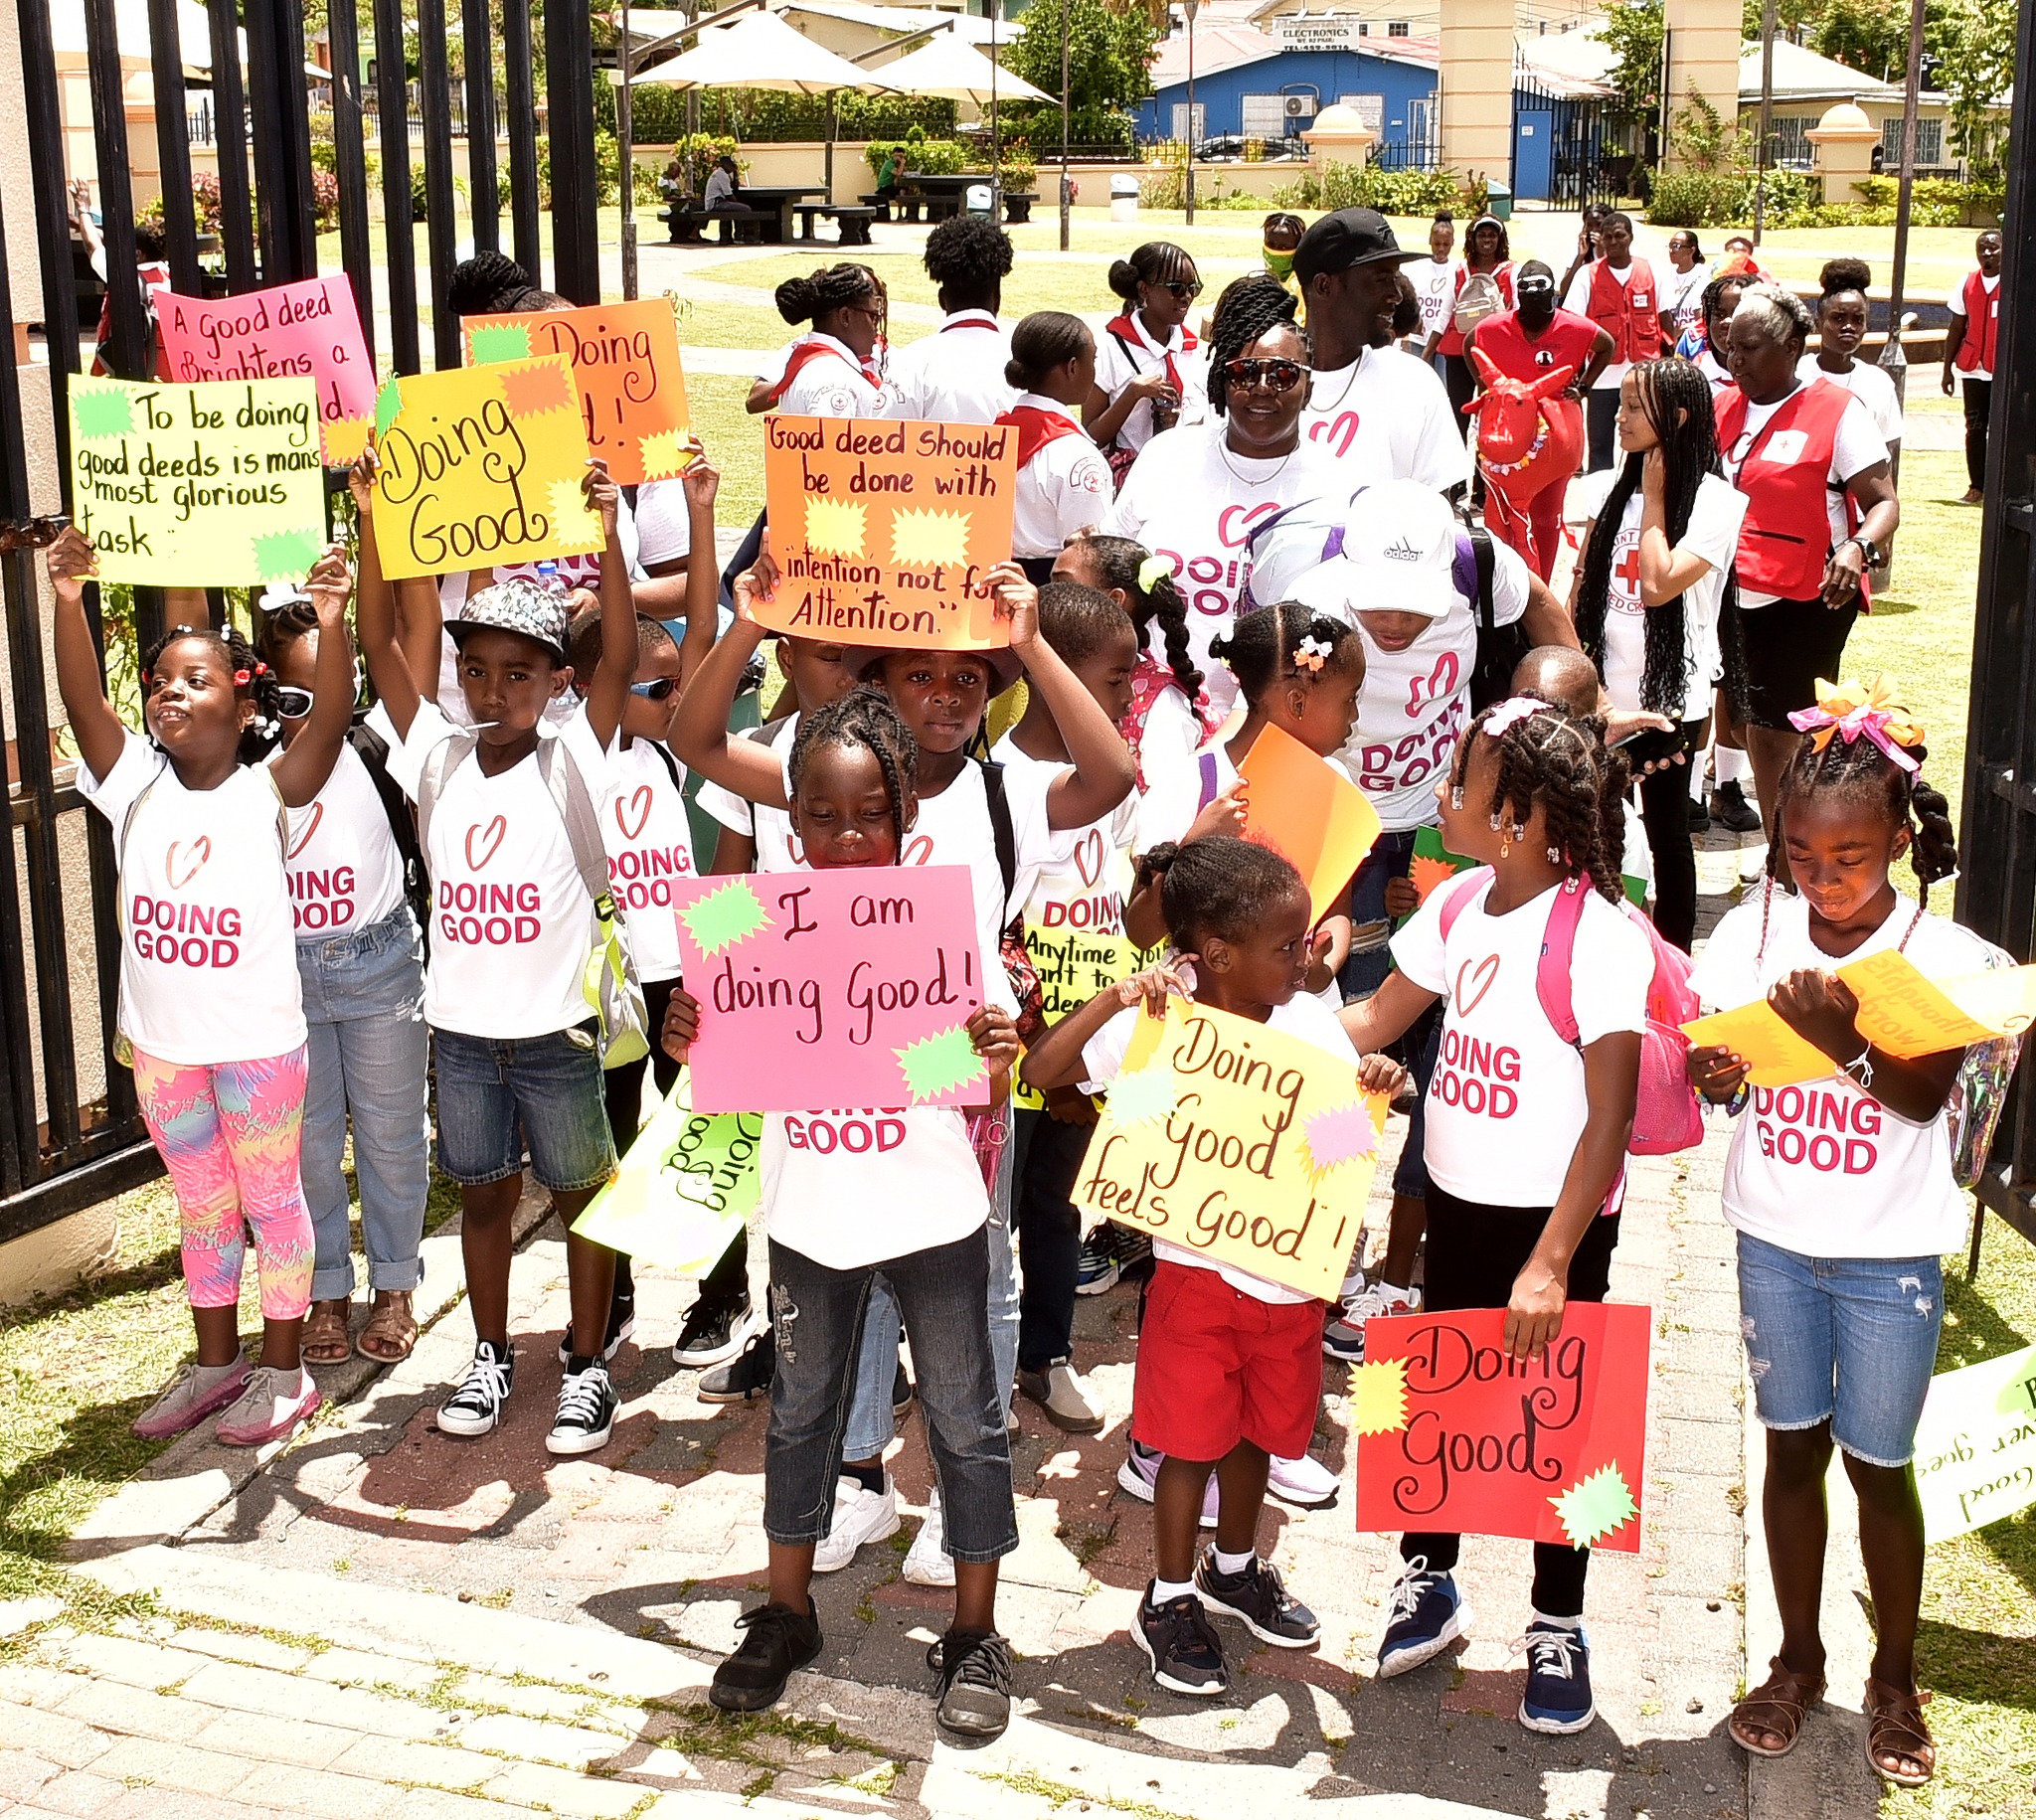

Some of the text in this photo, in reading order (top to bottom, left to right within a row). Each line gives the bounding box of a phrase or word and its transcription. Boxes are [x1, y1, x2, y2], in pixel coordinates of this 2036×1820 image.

[1282, 29, 1349, 38] ELECTRONICS
[174, 283, 333, 360] A Good deed
[331, 344, 351, 366] a
[539, 320, 657, 404] Doing
[189, 389, 225, 429] be
[236, 385, 309, 447] doing
[835, 419, 906, 455] deed
[78, 438, 129, 490] good
[137, 440, 221, 478] deeds
[233, 444, 259, 475] is
[380, 398, 527, 505] Doing
[801, 452, 997, 498] be done with
[94, 476, 288, 522] most glorious
[409, 463, 549, 565] Good
[82, 503, 153, 557] task
[897, 566, 947, 592] not
[1609, 593, 1624, 608] ED
[132, 895, 242, 937] DOING
[439, 879, 541, 914] DOING
[777, 885, 915, 942] I am
[134, 932, 240, 969] GOOD
[440, 912, 542, 944] GOOD
[1025, 930, 1117, 968] Anytime
[712, 947, 979, 1046] doing Good!
[1091, 968, 1116, 989] to
[1172, 1017, 1305, 1133] Doing
[1431, 1061, 1518, 1119] GOOD
[783, 1115, 907, 1155] GOOD
[1755, 1084, 1882, 1135] DOING
[1756, 1120, 1878, 1175] GOOD
[1083, 1135, 1170, 1226] feels
[1404, 1325, 1587, 1430] Doing
[1393, 1394, 1563, 1515] Good
[1991, 1423, 2036, 1454] ver
[1958, 1466, 2034, 1524] Good
